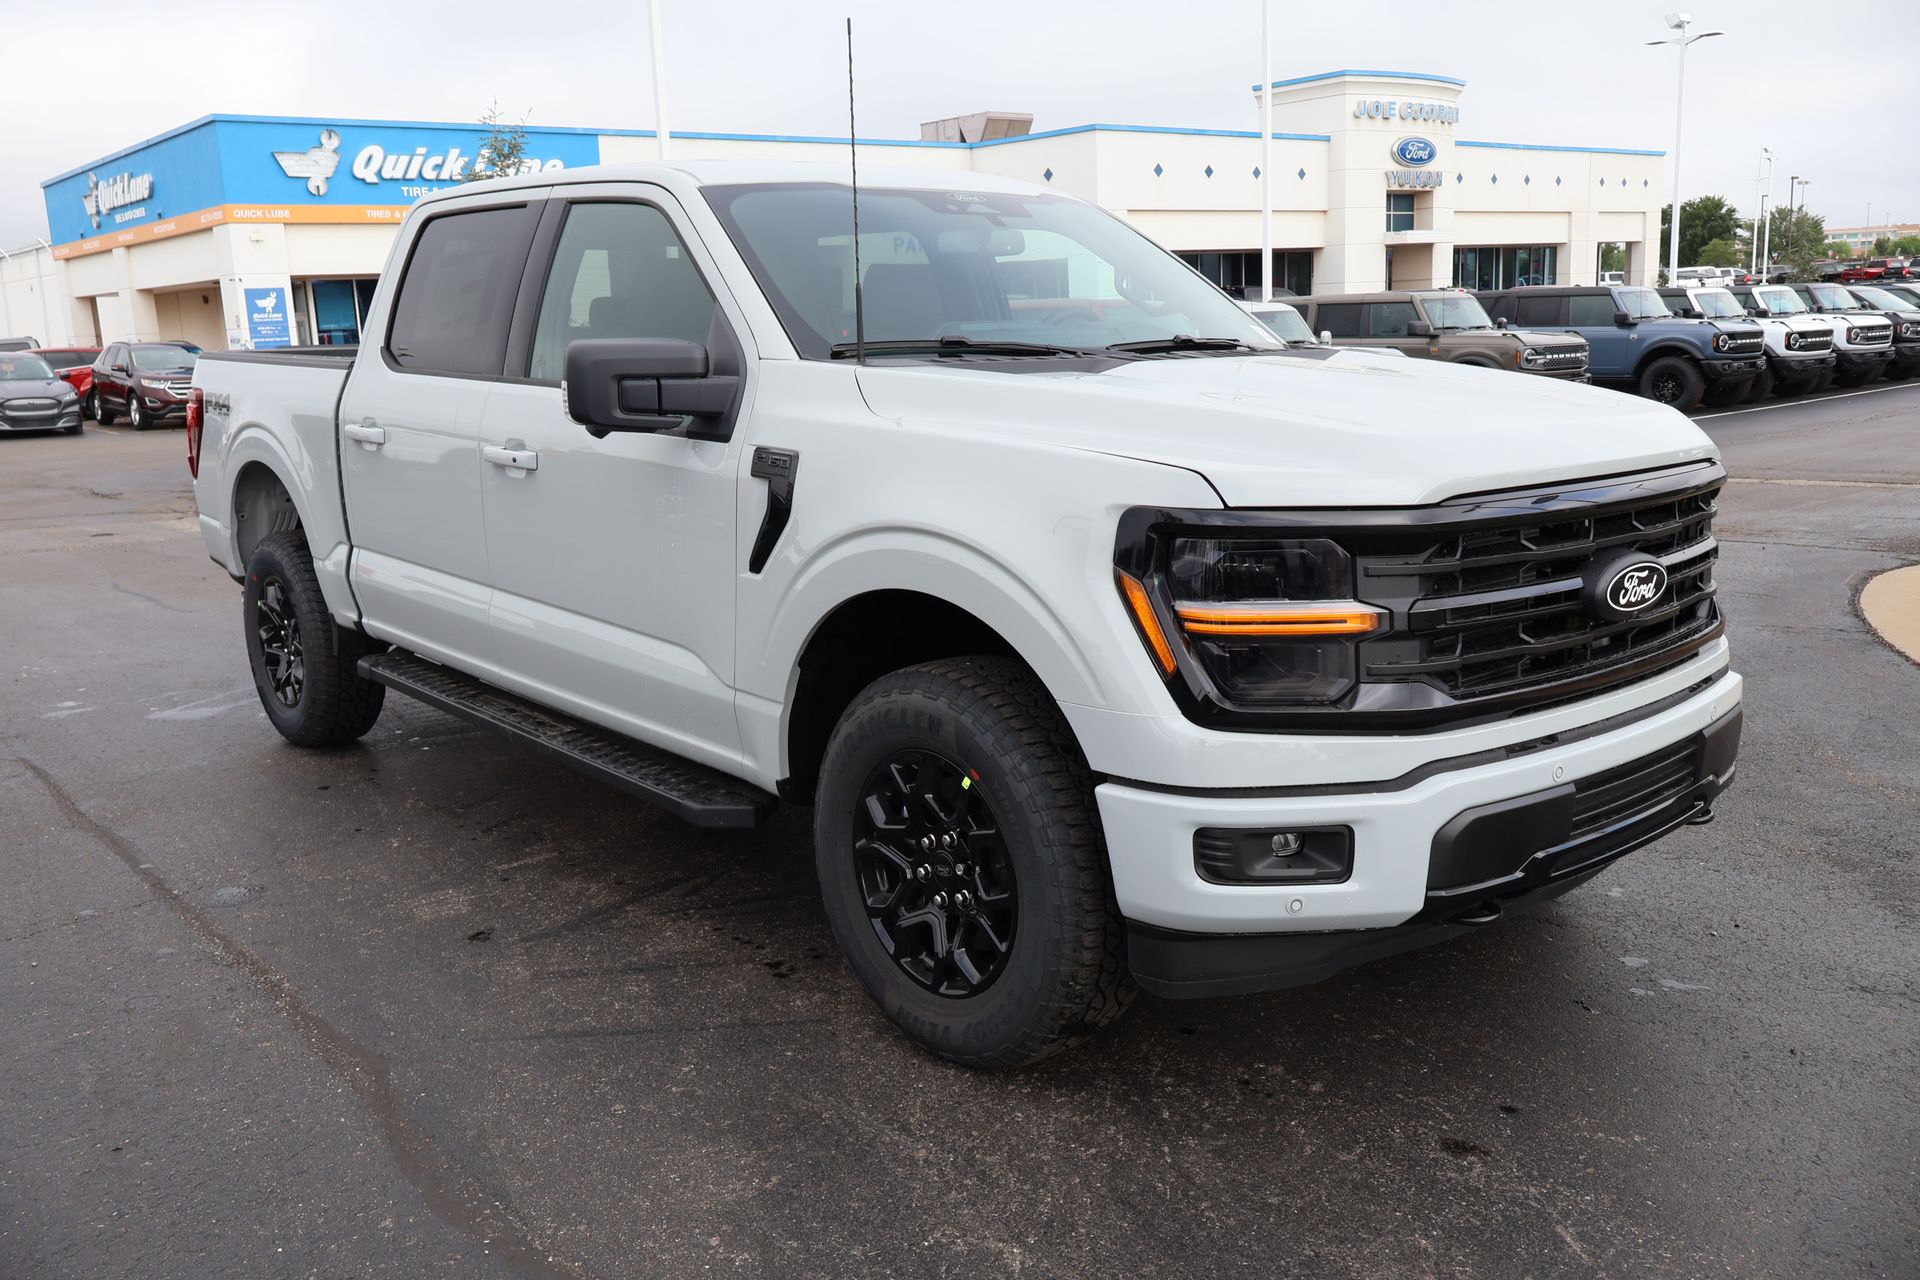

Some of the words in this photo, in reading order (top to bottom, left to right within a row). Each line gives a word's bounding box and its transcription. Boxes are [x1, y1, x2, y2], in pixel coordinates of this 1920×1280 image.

[1356, 100, 1396, 118] JOE
[1405, 142, 1430, 159] Ford
[352, 144, 470, 184] Quick
[1389, 171, 1443, 187] YUKON
[97, 174, 125, 214] Quick
[124, 172, 153, 206] Lane
[233, 209, 264, 218] QUICK
[266, 209, 290, 218] LUBE
[366, 209, 391, 218] TIRES
[893, 236, 923, 254] PA
[1618, 569, 1657, 605] Ford
